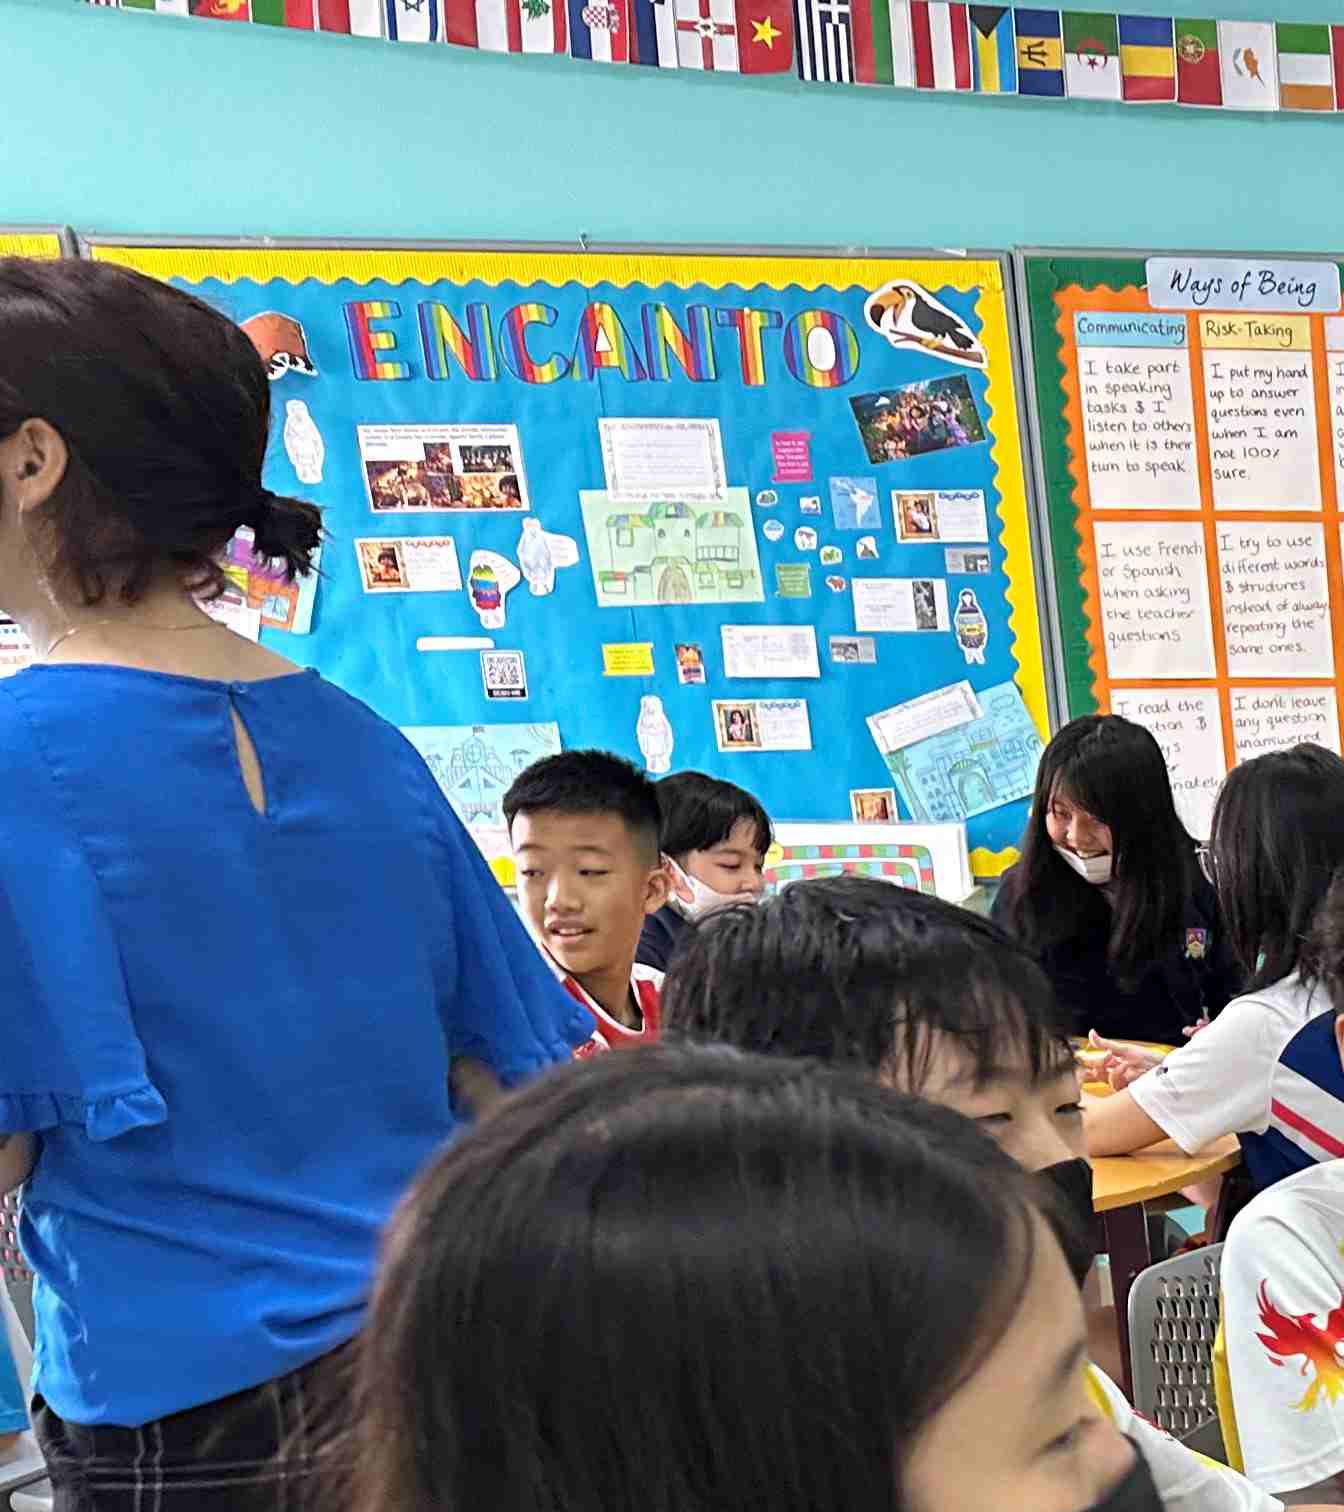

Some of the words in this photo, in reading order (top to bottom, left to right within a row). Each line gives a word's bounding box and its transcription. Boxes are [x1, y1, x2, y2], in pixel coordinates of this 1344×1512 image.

[1170, 267, 1222, 305] Ways
[1231, 271, 1252, 301] of
[1258, 270, 1316, 307] Being
[1078, 317, 1186, 344] Communicating
[344, 299, 862, 388] ENCANTO
[1084, 360, 1098, 375] I
[1106, 360, 1141, 374] take
[1148, 361, 1180, 380] part
[1211, 363, 1224, 379] I
[1230, 364, 1249, 382] put
[1254, 369, 1273, 384] my
[1276, 364, 1308, 378] hand
[1085, 384, 1097, 394] in
[1106, 381, 1172, 400] speaking
[1210, 389, 1225, 402] up
[1230, 388, 1243, 399] to
[1251, 388, 1299, 399] answer
[1087, 401, 1127, 413] tasks
[1153, 401, 1166, 413] I
[1211, 407, 1268, 423] questions
[1273, 407, 1305, 417] even
[1088, 420, 1126, 432] listen
[1132, 421, 1147, 431] to
[1153, 420, 1191, 432] others
[1212, 428, 1247, 439] when
[1253, 427, 1268, 438] I
[1275, 429, 1298, 438] am
[1089, 439, 1125, 450] when
[1130, 439, 1141, 450] it
[1146, 440, 1158, 450] is
[1213, 449, 1235, 460] not
[1126, 460, 1140, 472] to
